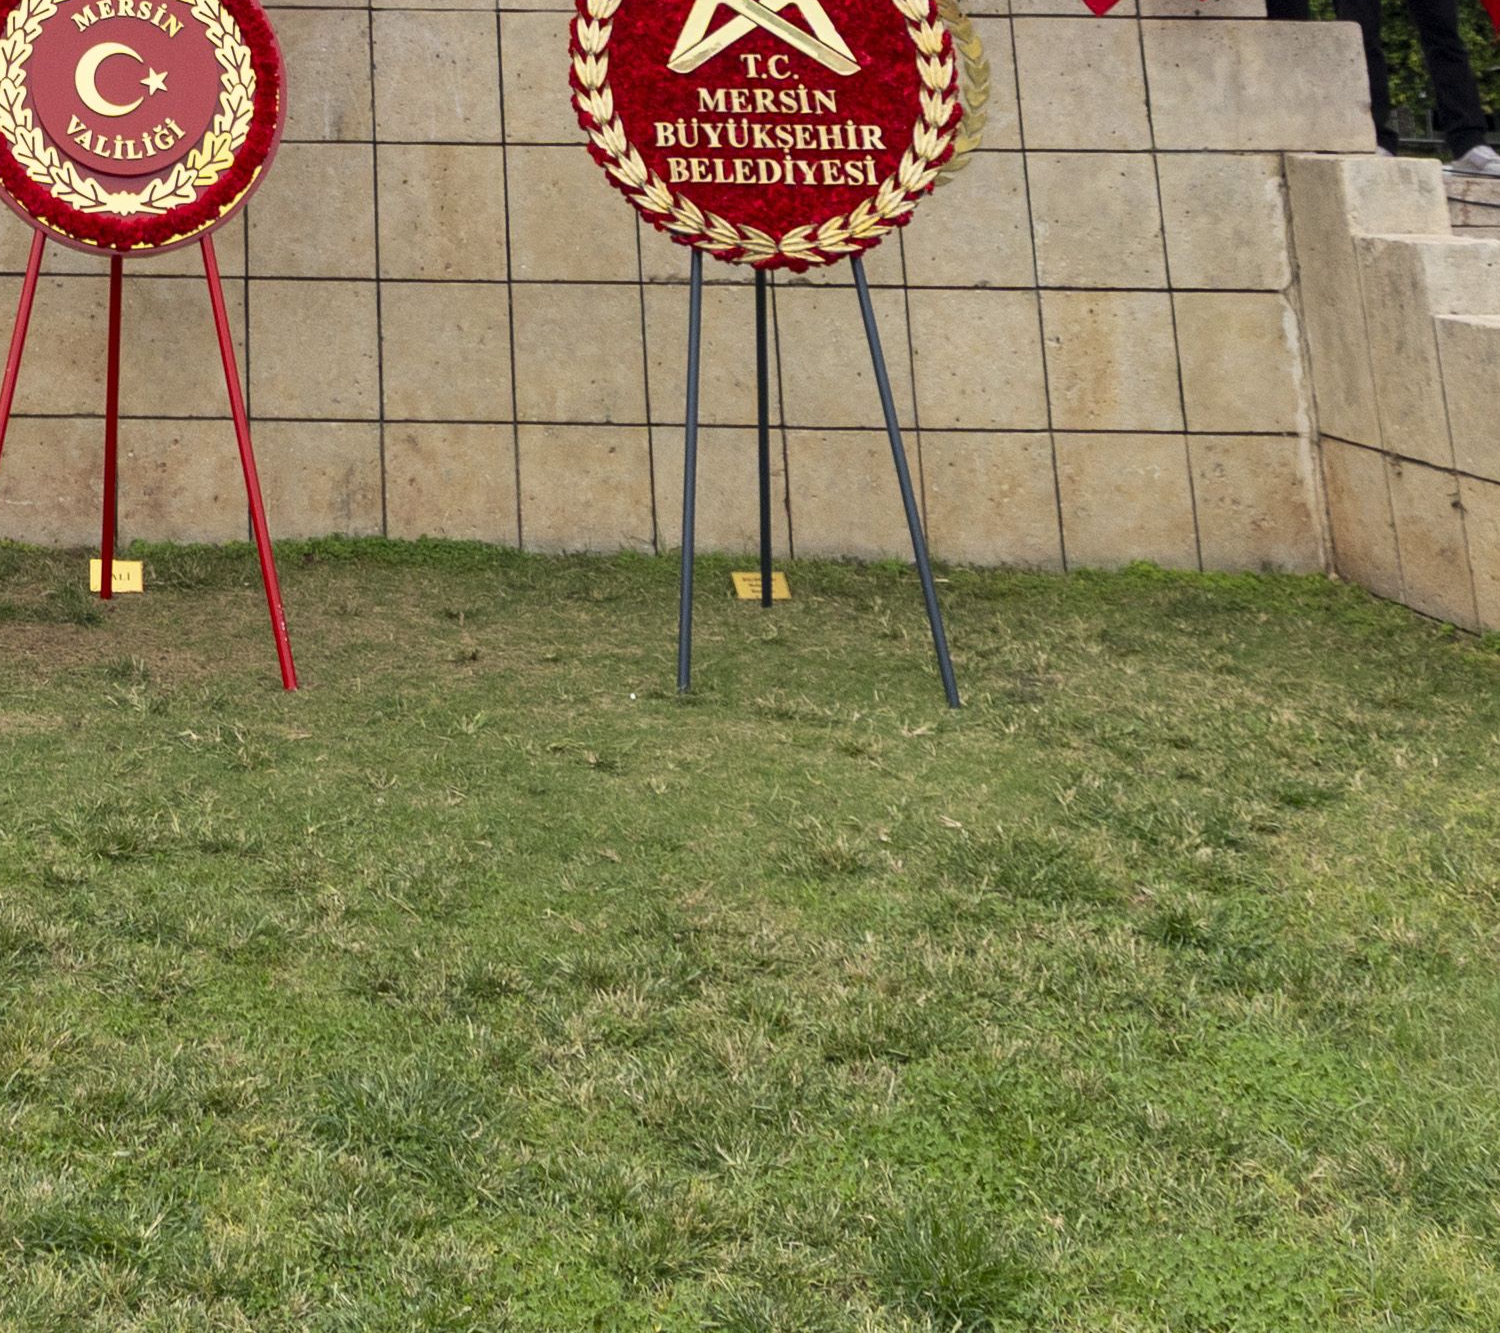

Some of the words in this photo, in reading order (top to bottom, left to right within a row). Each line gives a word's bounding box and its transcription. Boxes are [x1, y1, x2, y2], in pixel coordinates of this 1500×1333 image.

[739, 53, 799, 80] T.C.
[697, 83, 838, 115] MERSİN
[66, 114, 186, 160] VALİLİĞİ
[653, 117, 887, 154] BÜYÜKŞEHİR
[666, 154, 880, 186] BELEDİYESİ
